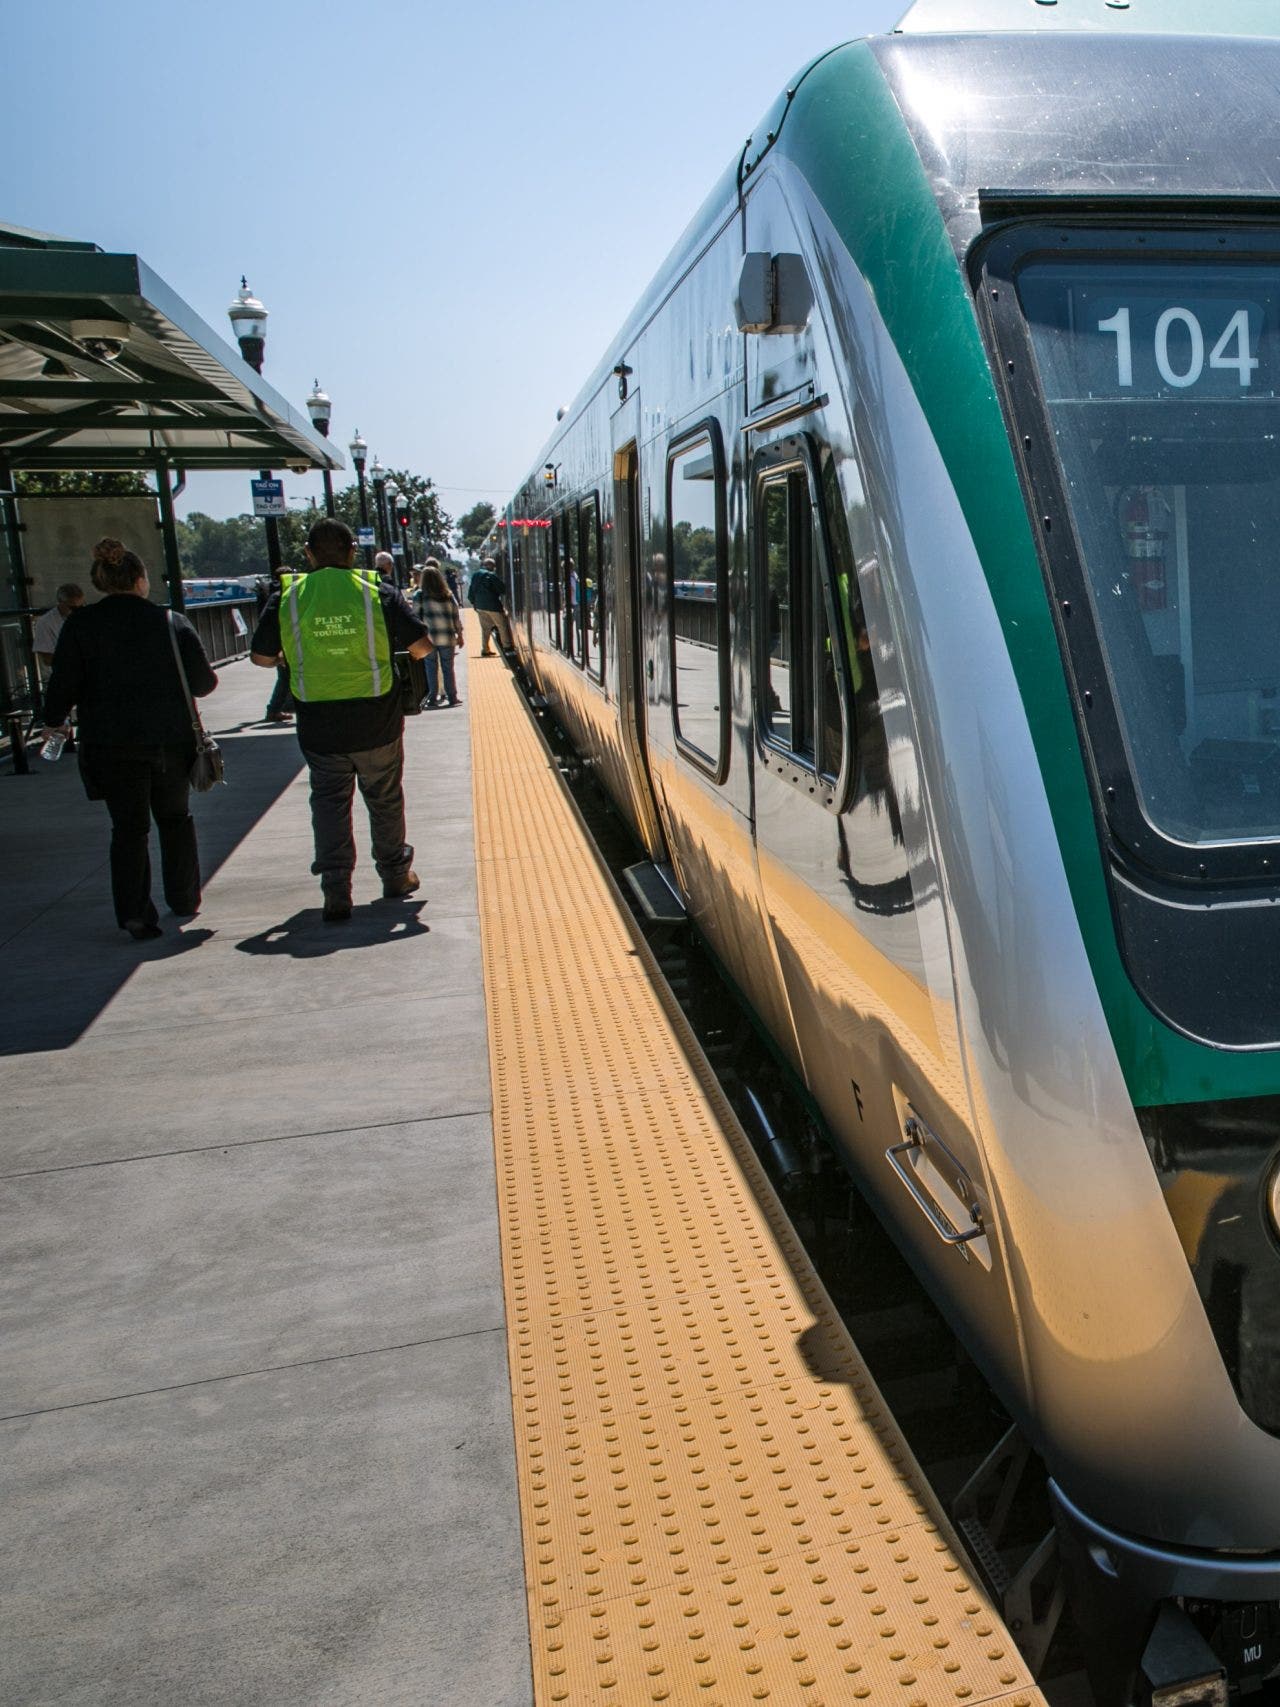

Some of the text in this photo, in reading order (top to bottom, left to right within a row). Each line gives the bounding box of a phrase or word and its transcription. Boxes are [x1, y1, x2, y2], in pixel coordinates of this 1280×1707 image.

[1098, 306, 1259, 388] 104
[315, 615, 352, 625] PLINY
[313, 628, 357, 637] YOUNGER
[1244, 1645, 1262, 1664] MU
